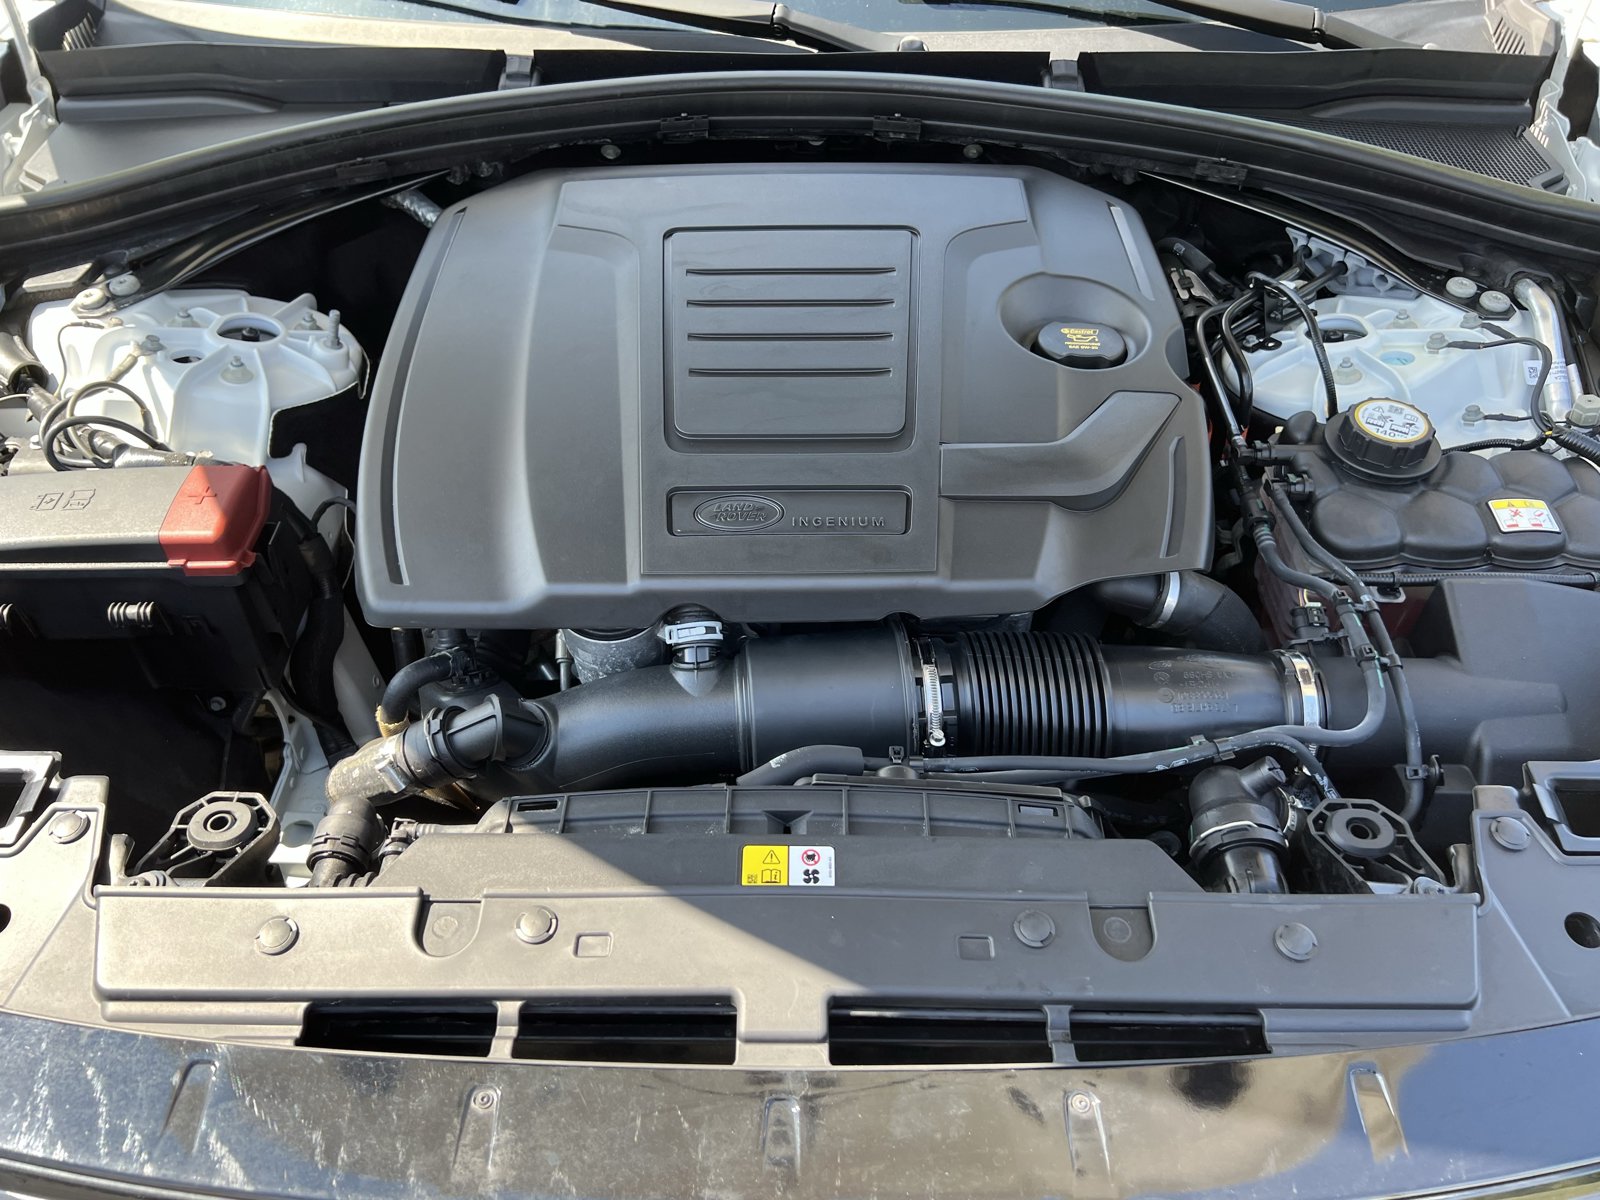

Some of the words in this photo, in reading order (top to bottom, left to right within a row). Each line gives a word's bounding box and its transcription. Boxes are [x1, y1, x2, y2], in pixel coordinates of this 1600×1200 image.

[1375, 427, 1396, 438] 140
[713, 502, 756, 512] LAND
[715, 511, 767, 522] ROVER
[791, 516, 885, 527] INGENIUM
